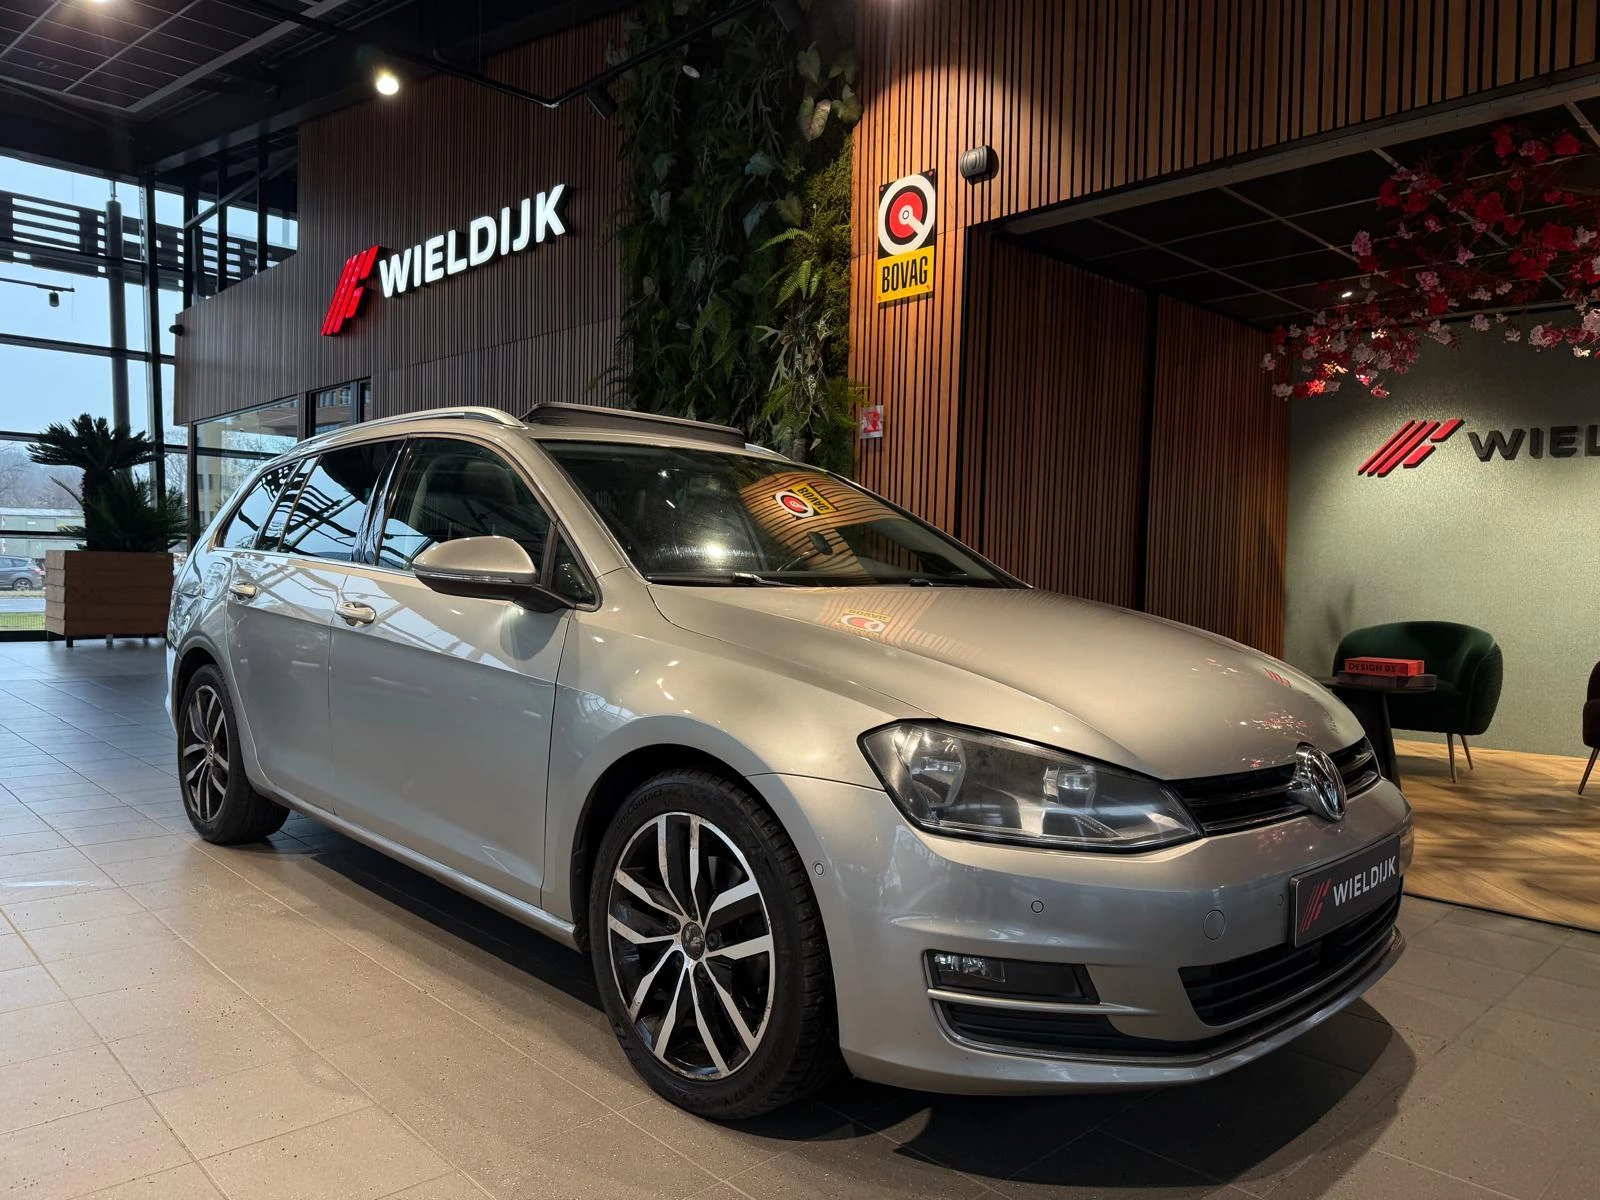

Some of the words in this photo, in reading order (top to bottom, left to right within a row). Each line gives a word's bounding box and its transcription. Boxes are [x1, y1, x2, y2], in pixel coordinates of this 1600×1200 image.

[378, 184, 566, 299] WIELDIJK
[882, 256, 928, 294] BOVAG
[1467, 425, 1600, 462] WIEL
[1348, 662, 1383, 672] DESIGN
[1333, 855, 1396, 907] WIELDIJK
